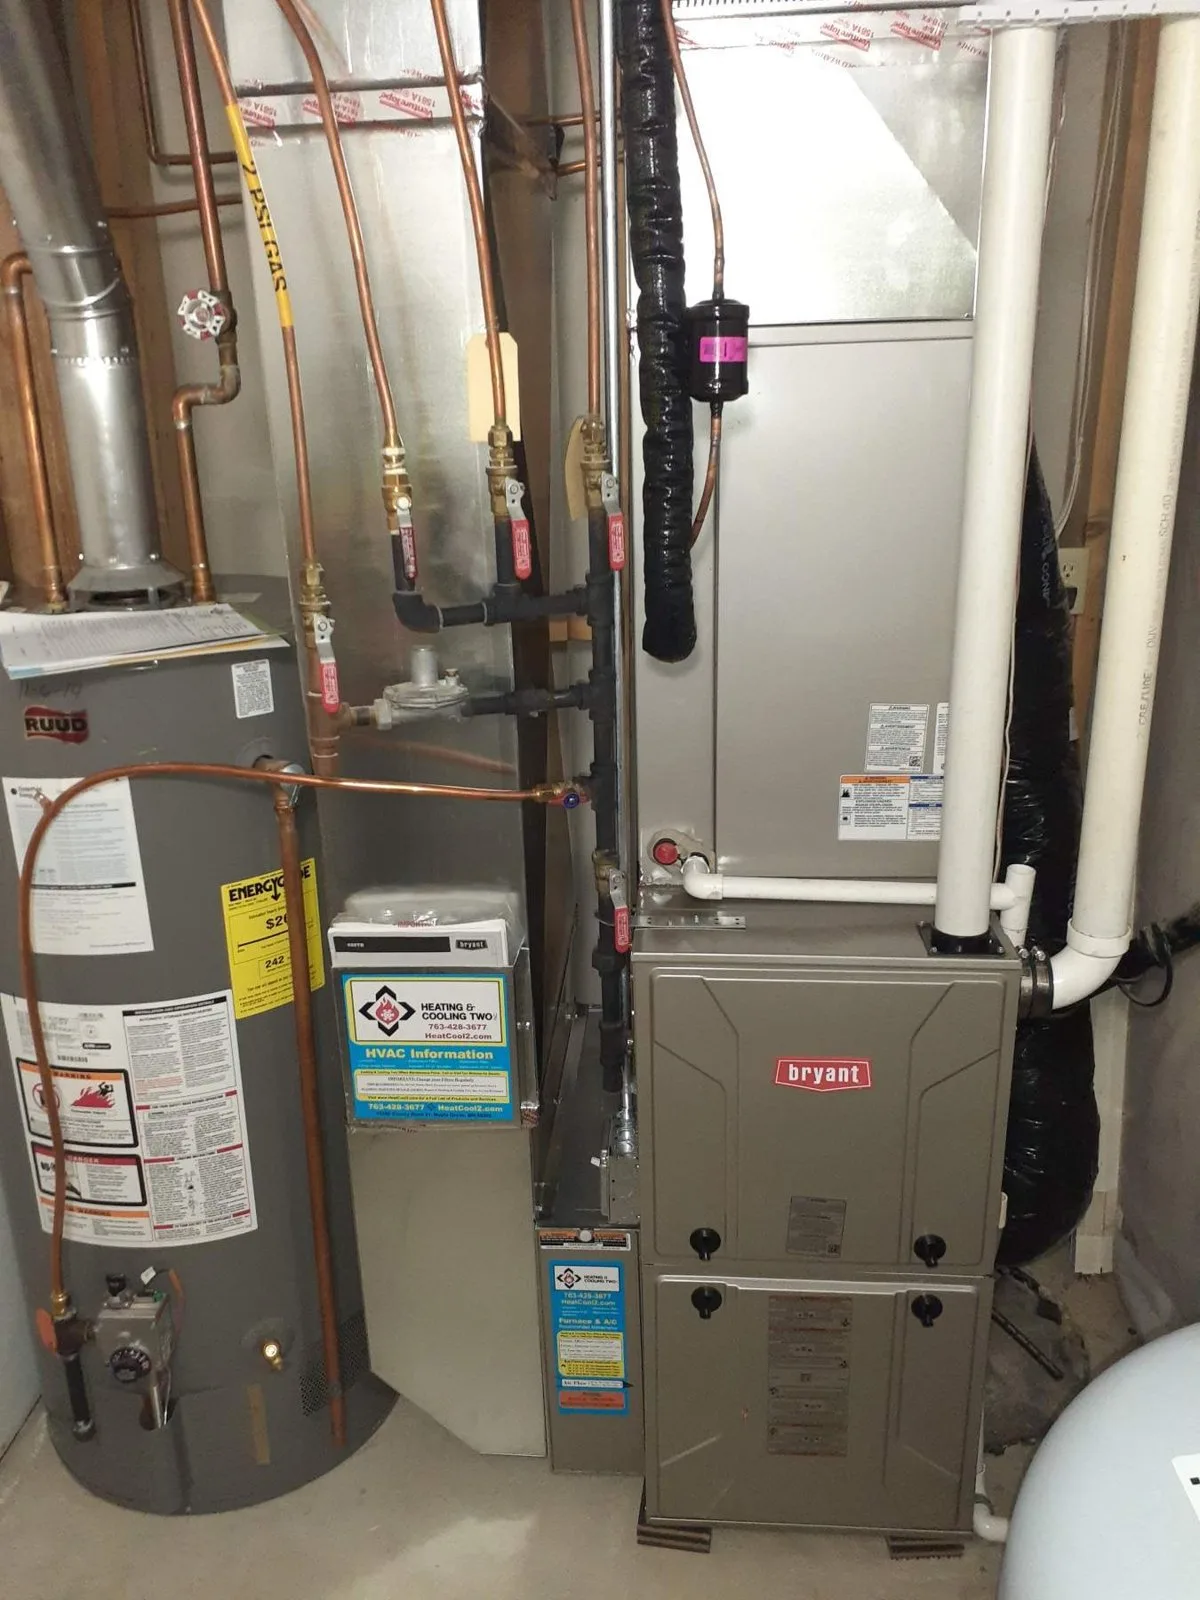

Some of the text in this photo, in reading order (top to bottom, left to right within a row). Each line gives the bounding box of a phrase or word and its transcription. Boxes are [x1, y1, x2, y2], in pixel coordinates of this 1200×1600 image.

[249, 188, 272, 229] PSI
[264, 240, 288, 292] GAS
[25, 716, 89, 732] RUUD
[459, 940, 485, 949] bryant
[265, 955, 285, 968] 242
[421, 1003, 463, 1012] HEATING
[421, 1012, 493, 1021] COOLING TWO
[428, 1023, 488, 1031] 763-428-3677
[425, 1032, 493, 1041] HeatCool2.com
[365, 1048, 494, 1060] HVAC Information
[53, 1071, 92, 1080] WARNING
[788, 1063, 860, 1085] bryant
[368, 1103, 503, 1113] 763-428-3677 HeatCool2.com
[67, 1155, 100, 1164] DANGER
[559, 1317, 592, 1325] Furnace
